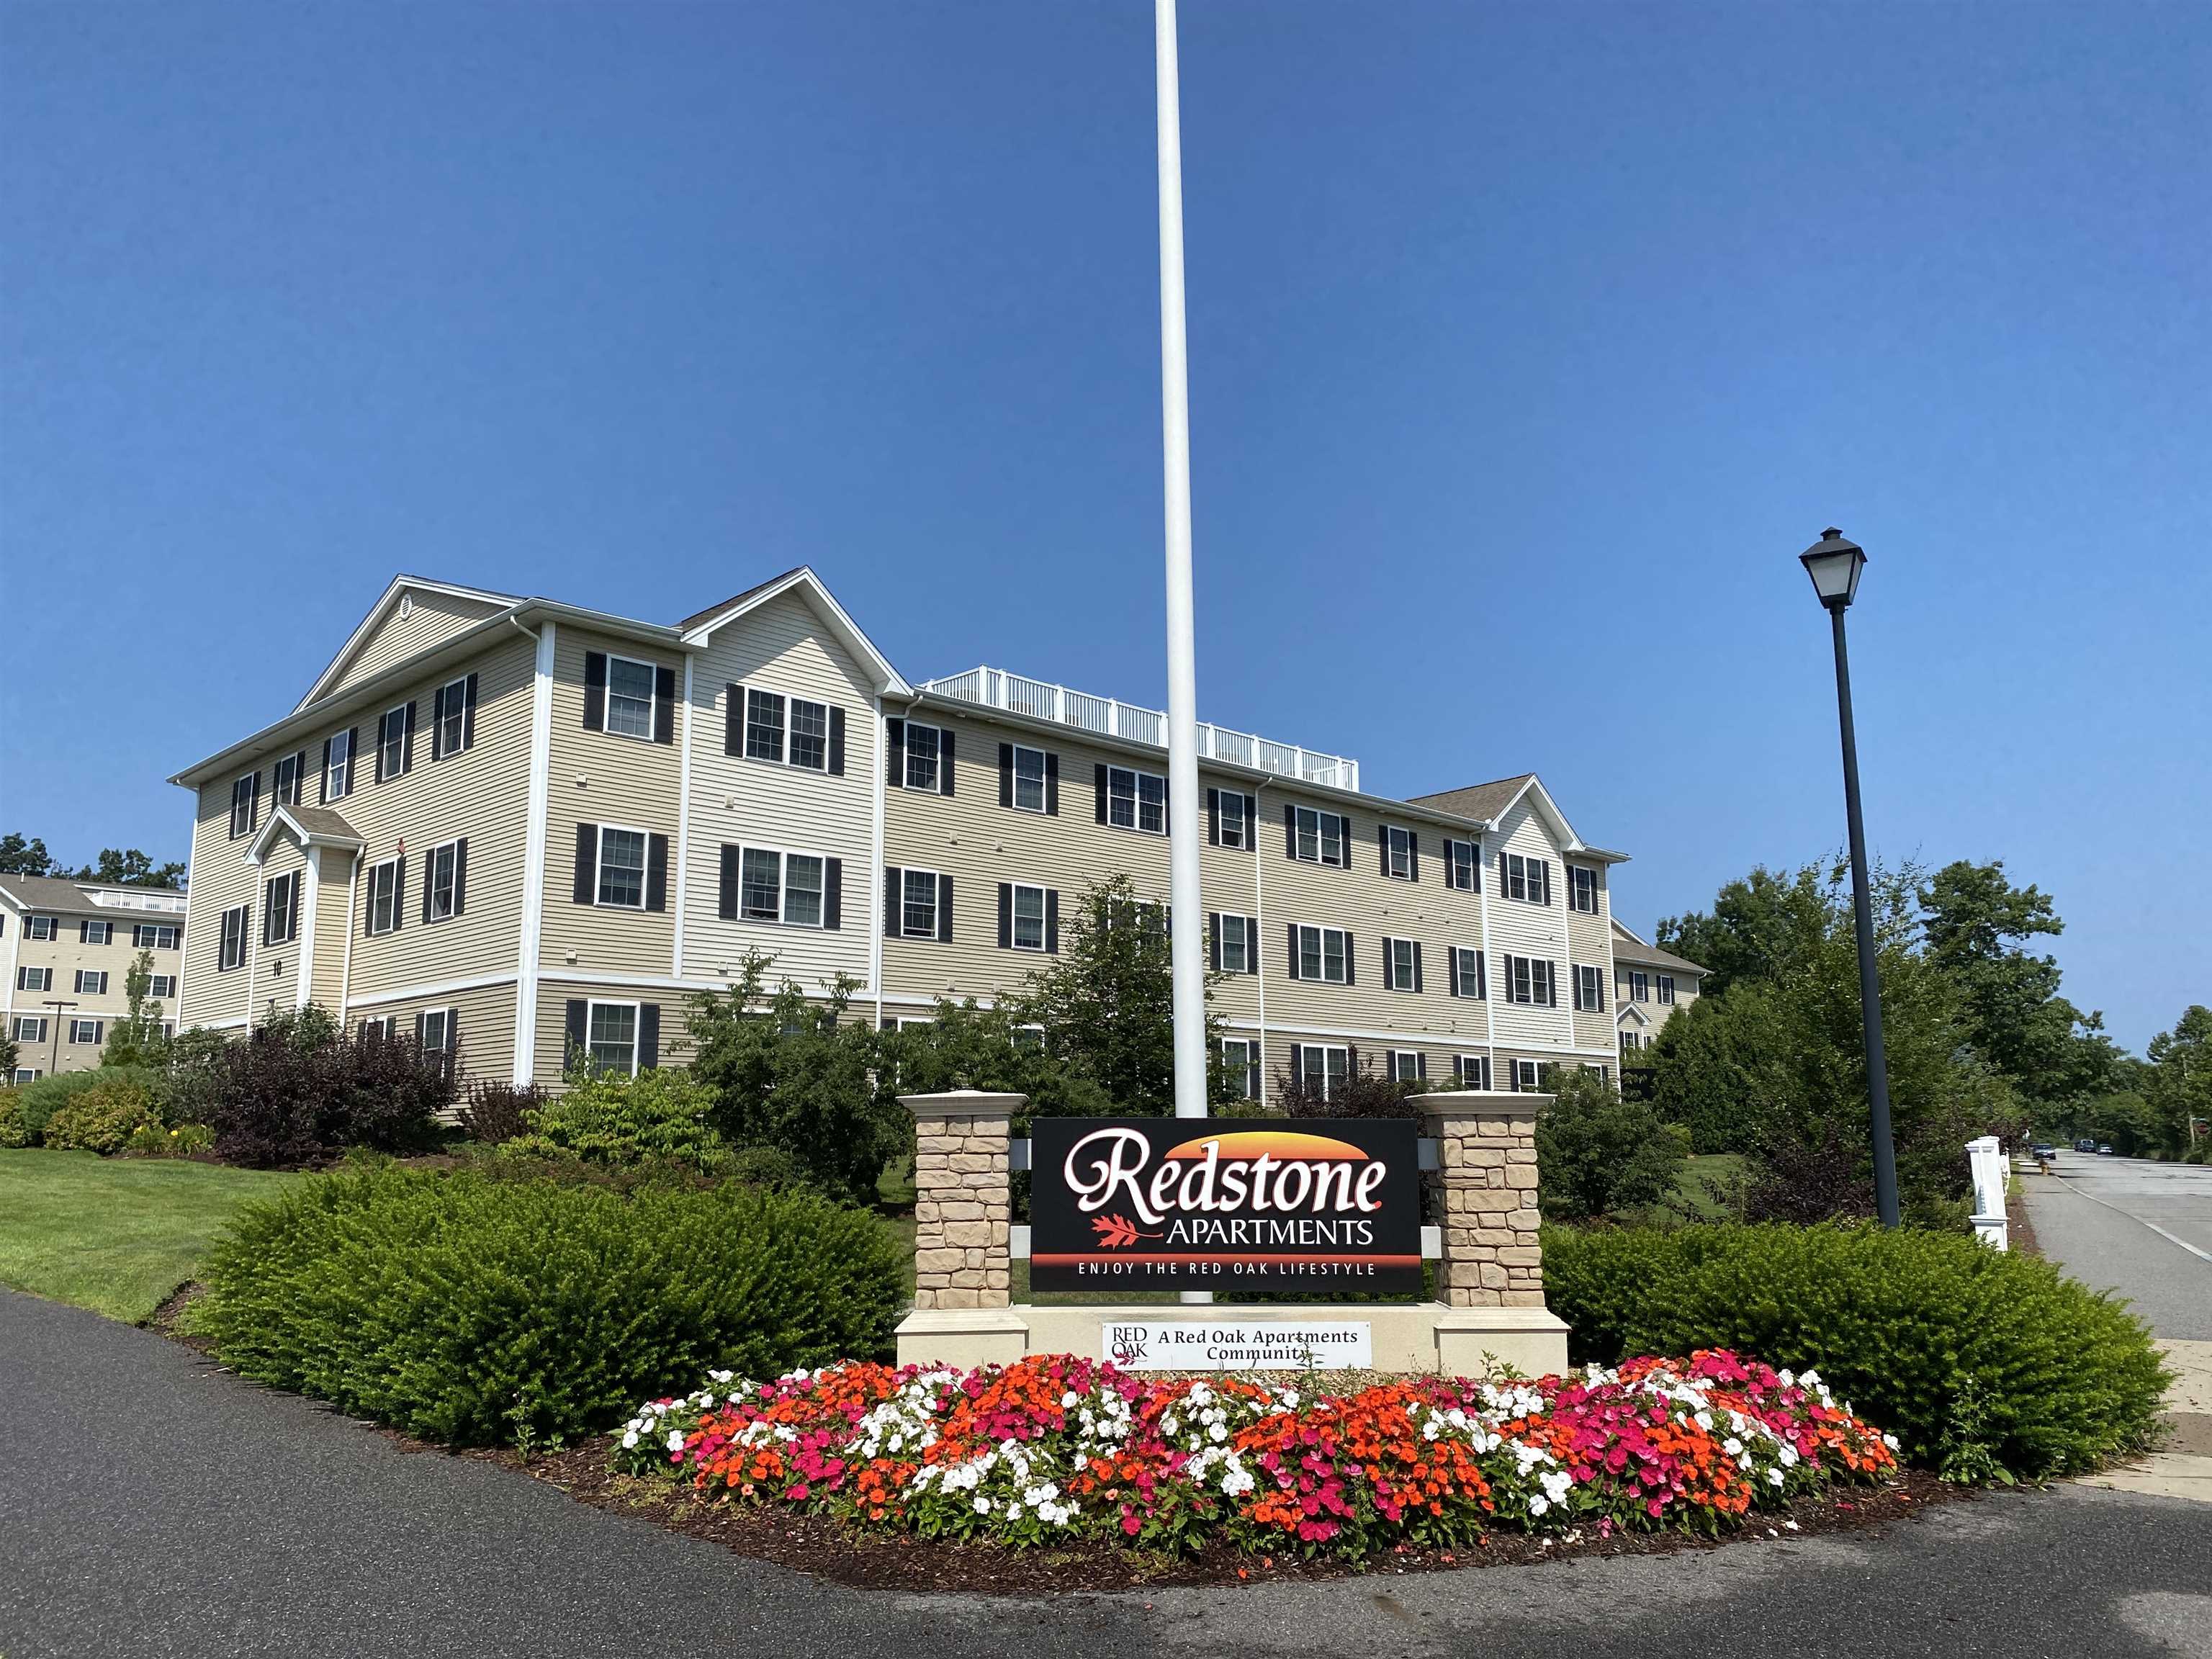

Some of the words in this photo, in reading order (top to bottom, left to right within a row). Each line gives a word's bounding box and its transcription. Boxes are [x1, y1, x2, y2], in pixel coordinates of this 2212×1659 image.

[273, 960, 282, 977] 10
[1064, 1127, 1387, 1225] Redstone
[1166, 1219, 1374, 1245] APARTMENTS
[1079, 1262, 1134, 1274] ENJOY
[1145, 1262, 1177, 1274] THE
[1190, 1262, 1221, 1274] RED
[1233, 1262, 1268, 1274] OAK
[1280, 1262, 1375, 1275] LIFESTYLE
[1113, 1327, 1148, 1343] RED
[1158, 1331, 1170, 1344] A
[1174, 1329, 1206, 1344] Red
[1212, 1329, 1246, 1344] Oak
[1252, 1330, 1358, 1347] Apartments
[1112, 1342, 1148, 1358] OAK
[1207, 1345, 1308, 1363] Community
